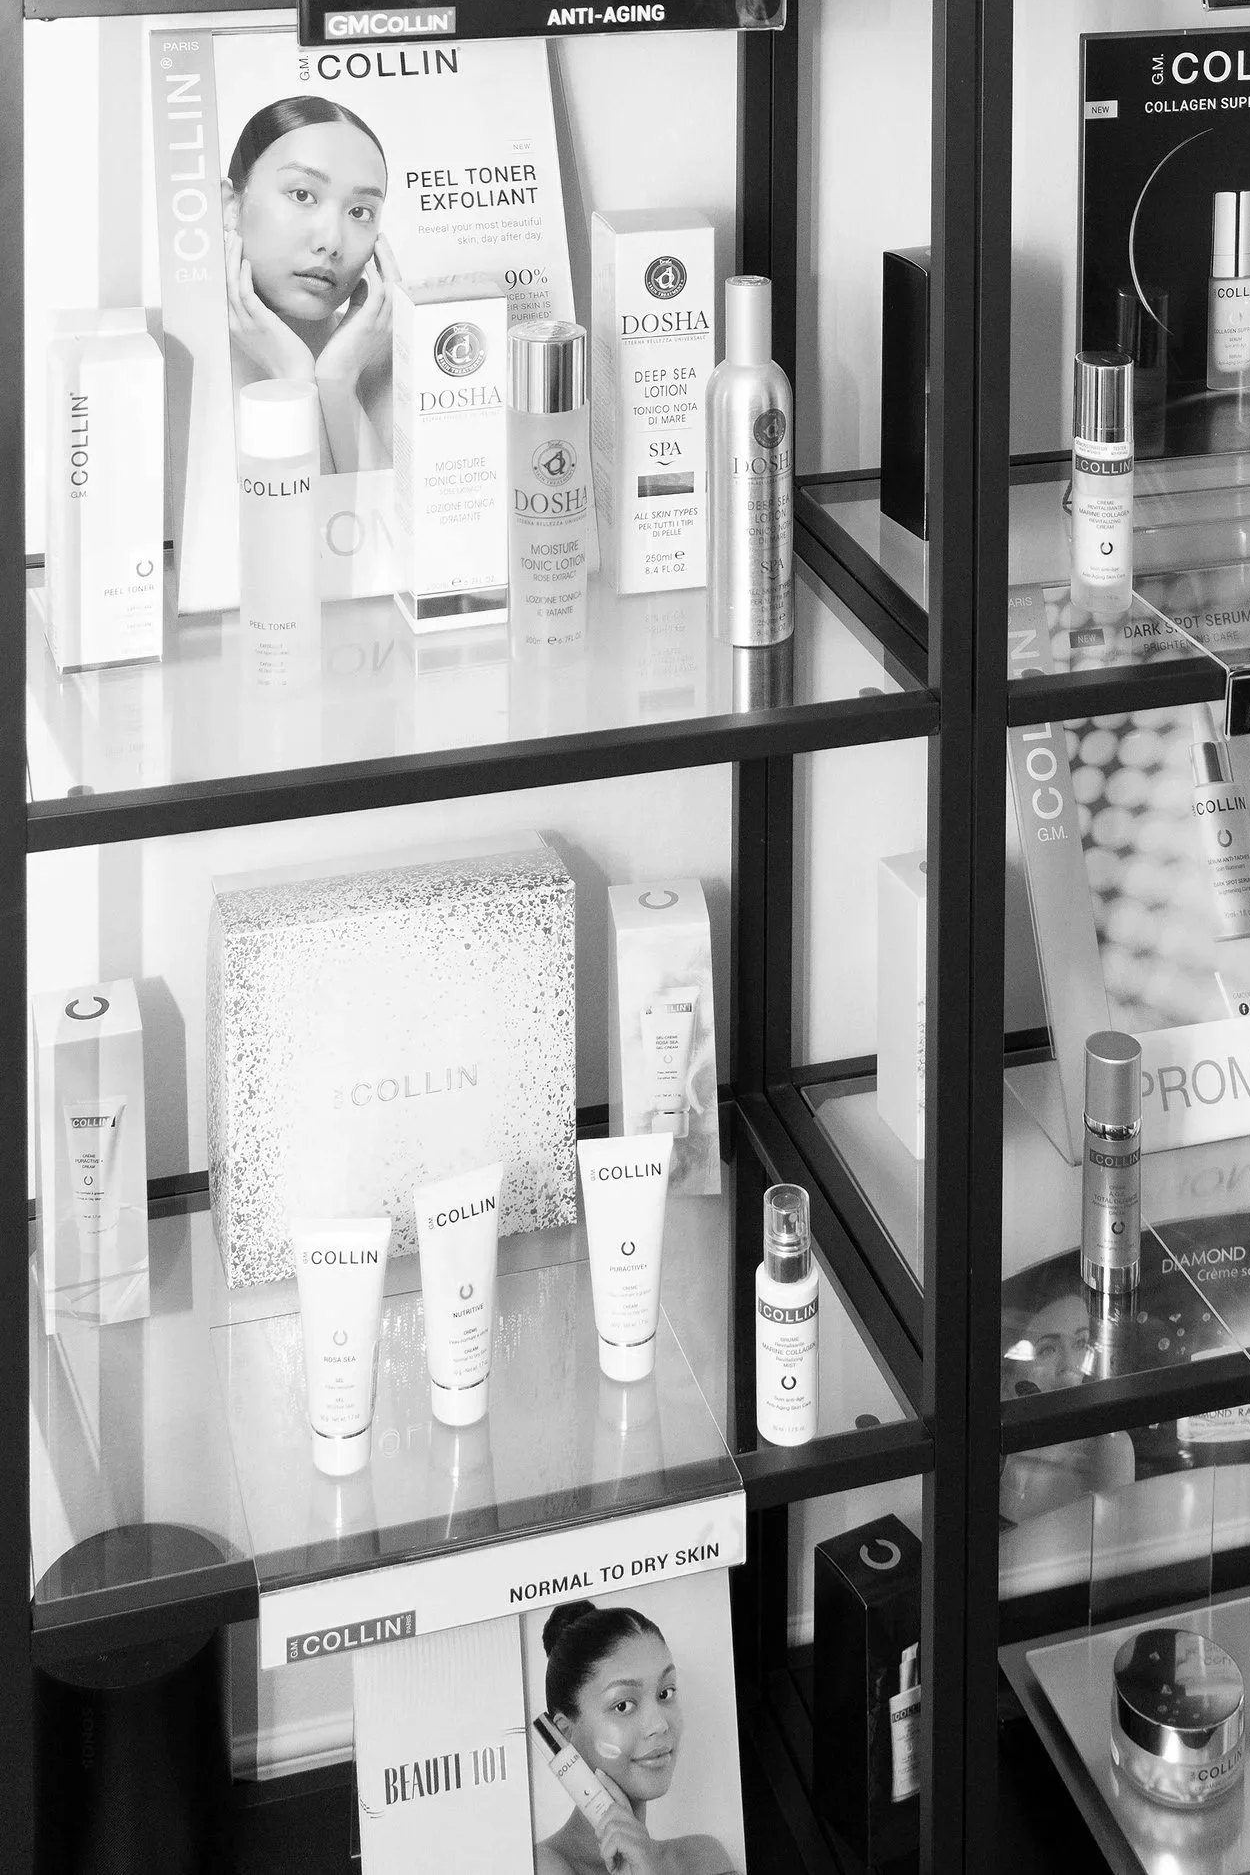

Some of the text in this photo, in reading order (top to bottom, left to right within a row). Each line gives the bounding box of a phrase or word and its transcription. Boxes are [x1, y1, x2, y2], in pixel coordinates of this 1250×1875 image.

[548, 4, 665, 26] ANTI-AGING
[163, 42, 199, 51] PARIS
[318, 49, 458, 79] COLLIN
[1092, 106, 1109, 114] NEW
[1145, 99, 1216, 114] COLLAGEN
[513, 142, 531, 150] NEW
[166, 73, 211, 262] COLLIN
[406, 165, 537, 188] PEEL TONER
[420, 188, 538, 211] EXFOLIANT
[418, 217, 542, 234] Reveal your most beautiful
[457, 235, 479, 246] skin,
[482, 235, 498, 245] day
[500, 232, 521, 242] after
[505, 269, 548, 289] 90%
[528, 291, 549, 299] THAT
[522, 302, 539, 310] SKIN
[621, 310, 710, 335] DOSHA
[635, 368, 696, 383] DEEP SEA
[419, 387, 503, 411] DOSHA
[645, 384, 687, 398] LOTION
[633, 403, 698, 416] TONICO NOTA
[648, 414, 686, 425] DI MARE
[71, 394, 88, 486] COLLIN
[649, 442, 681, 457] SPA
[435, 457, 485, 471] MOISTURE
[1081, 458, 1130, 474] COLLIN
[425, 471, 497, 487] TONIC LOTION
[244, 477, 311, 498] COLLIN
[514, 487, 587, 513] DOSHA
[634, 507, 698, 521] ALL SKIN TYPES
[639, 518, 693, 531] PER TUTTI TIPI
[662, 528, 681, 537] PELLE
[530, 540, 579, 555] MOISTURE
[521, 554, 586, 570] TONIC LOTION
[104, 584, 154, 597] PEEL TONER
[249, 621, 296, 630] PEEL TONER
[1123, 623, 1161, 639] DARK
[1165, 617, 1200, 633] SPOT
[1078, 634, 1096, 643] NEW
[1213, 631, 1239, 641] CARE
[1197, 797, 1247, 815] COLLIN
[351, 1064, 477, 1106] COLLIN
[599, 1163, 662, 1180] COLLIN
[437, 1196, 495, 1227] COLLIN
[312, 1251, 378, 1265] COLLIN
[1162, 1246, 1246, 1274] DIAMOND
[1197, 1268, 1239, 1282] Crème
[453, 1303, 484, 1318] NUTRITIVE
[764, 1303, 816, 1322] COLLIN
[762, 1342, 816, 1356] MARINE COLLAGEN
[510, 1543, 720, 1603] NORMAL TO DRY SKIN
[303, 1617, 401, 1655] COLLIN
[470, 1746, 506, 1785] 101
[1198, 1750, 1242, 1782] COLLIN
